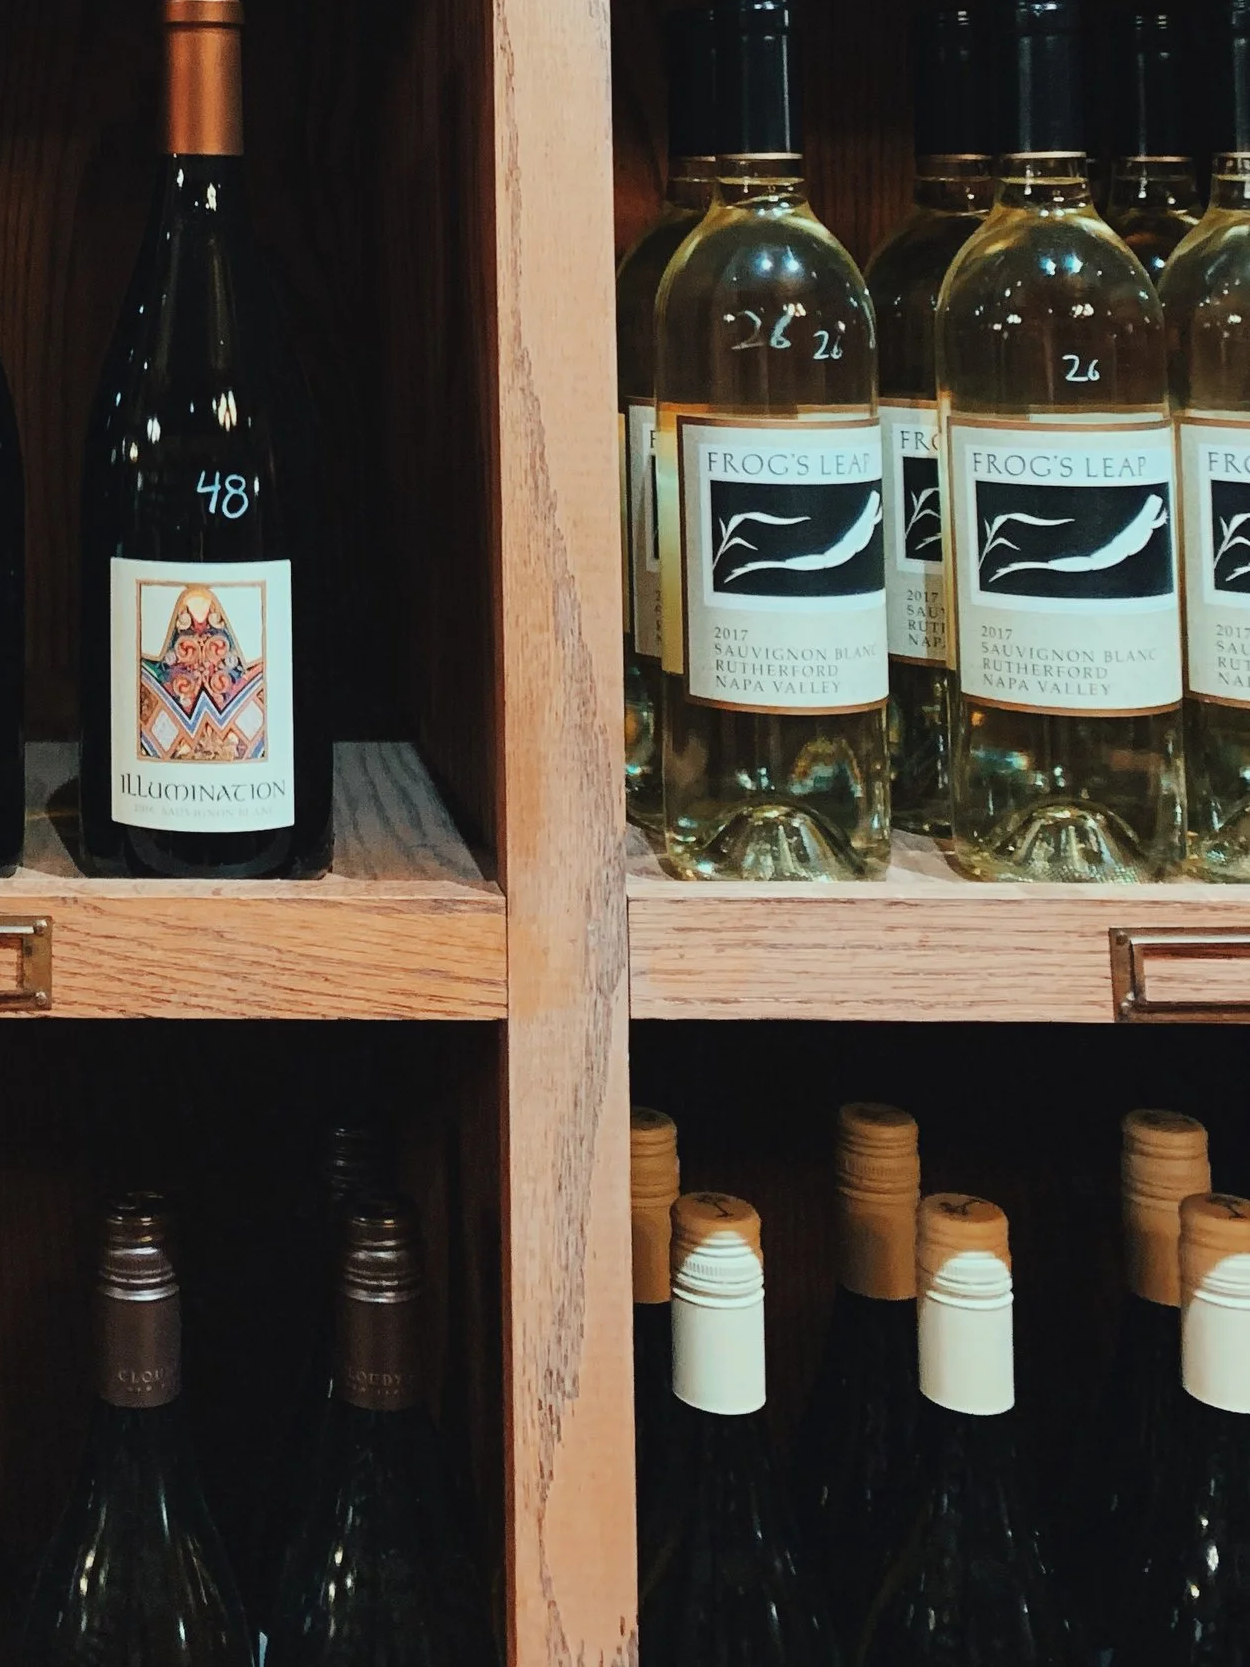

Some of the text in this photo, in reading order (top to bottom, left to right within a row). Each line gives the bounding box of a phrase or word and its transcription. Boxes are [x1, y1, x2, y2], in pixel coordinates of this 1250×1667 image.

[1062, 353, 1100, 383] 26
[707, 452, 870, 476] FROG'S LEAP
[973, 452, 1147, 478] FROG'S LEAP
[196, 470, 249, 519] 48
[714, 626, 748, 641] 2017
[982, 625, 1013, 640] 2017
[714, 643, 877, 661] SAUVIGNON BLANC
[982, 641, 1158, 664] SAUVIGNON BLANC
[715, 659, 839, 677] RUTHERFORD
[982, 657, 1108, 680] RUTHERFORD
[715, 675, 841, 694] NAPA VALLEY
[983, 674, 1112, 696] NAPA VALLEY
[120, 772, 287, 803] ILLUMINATION
